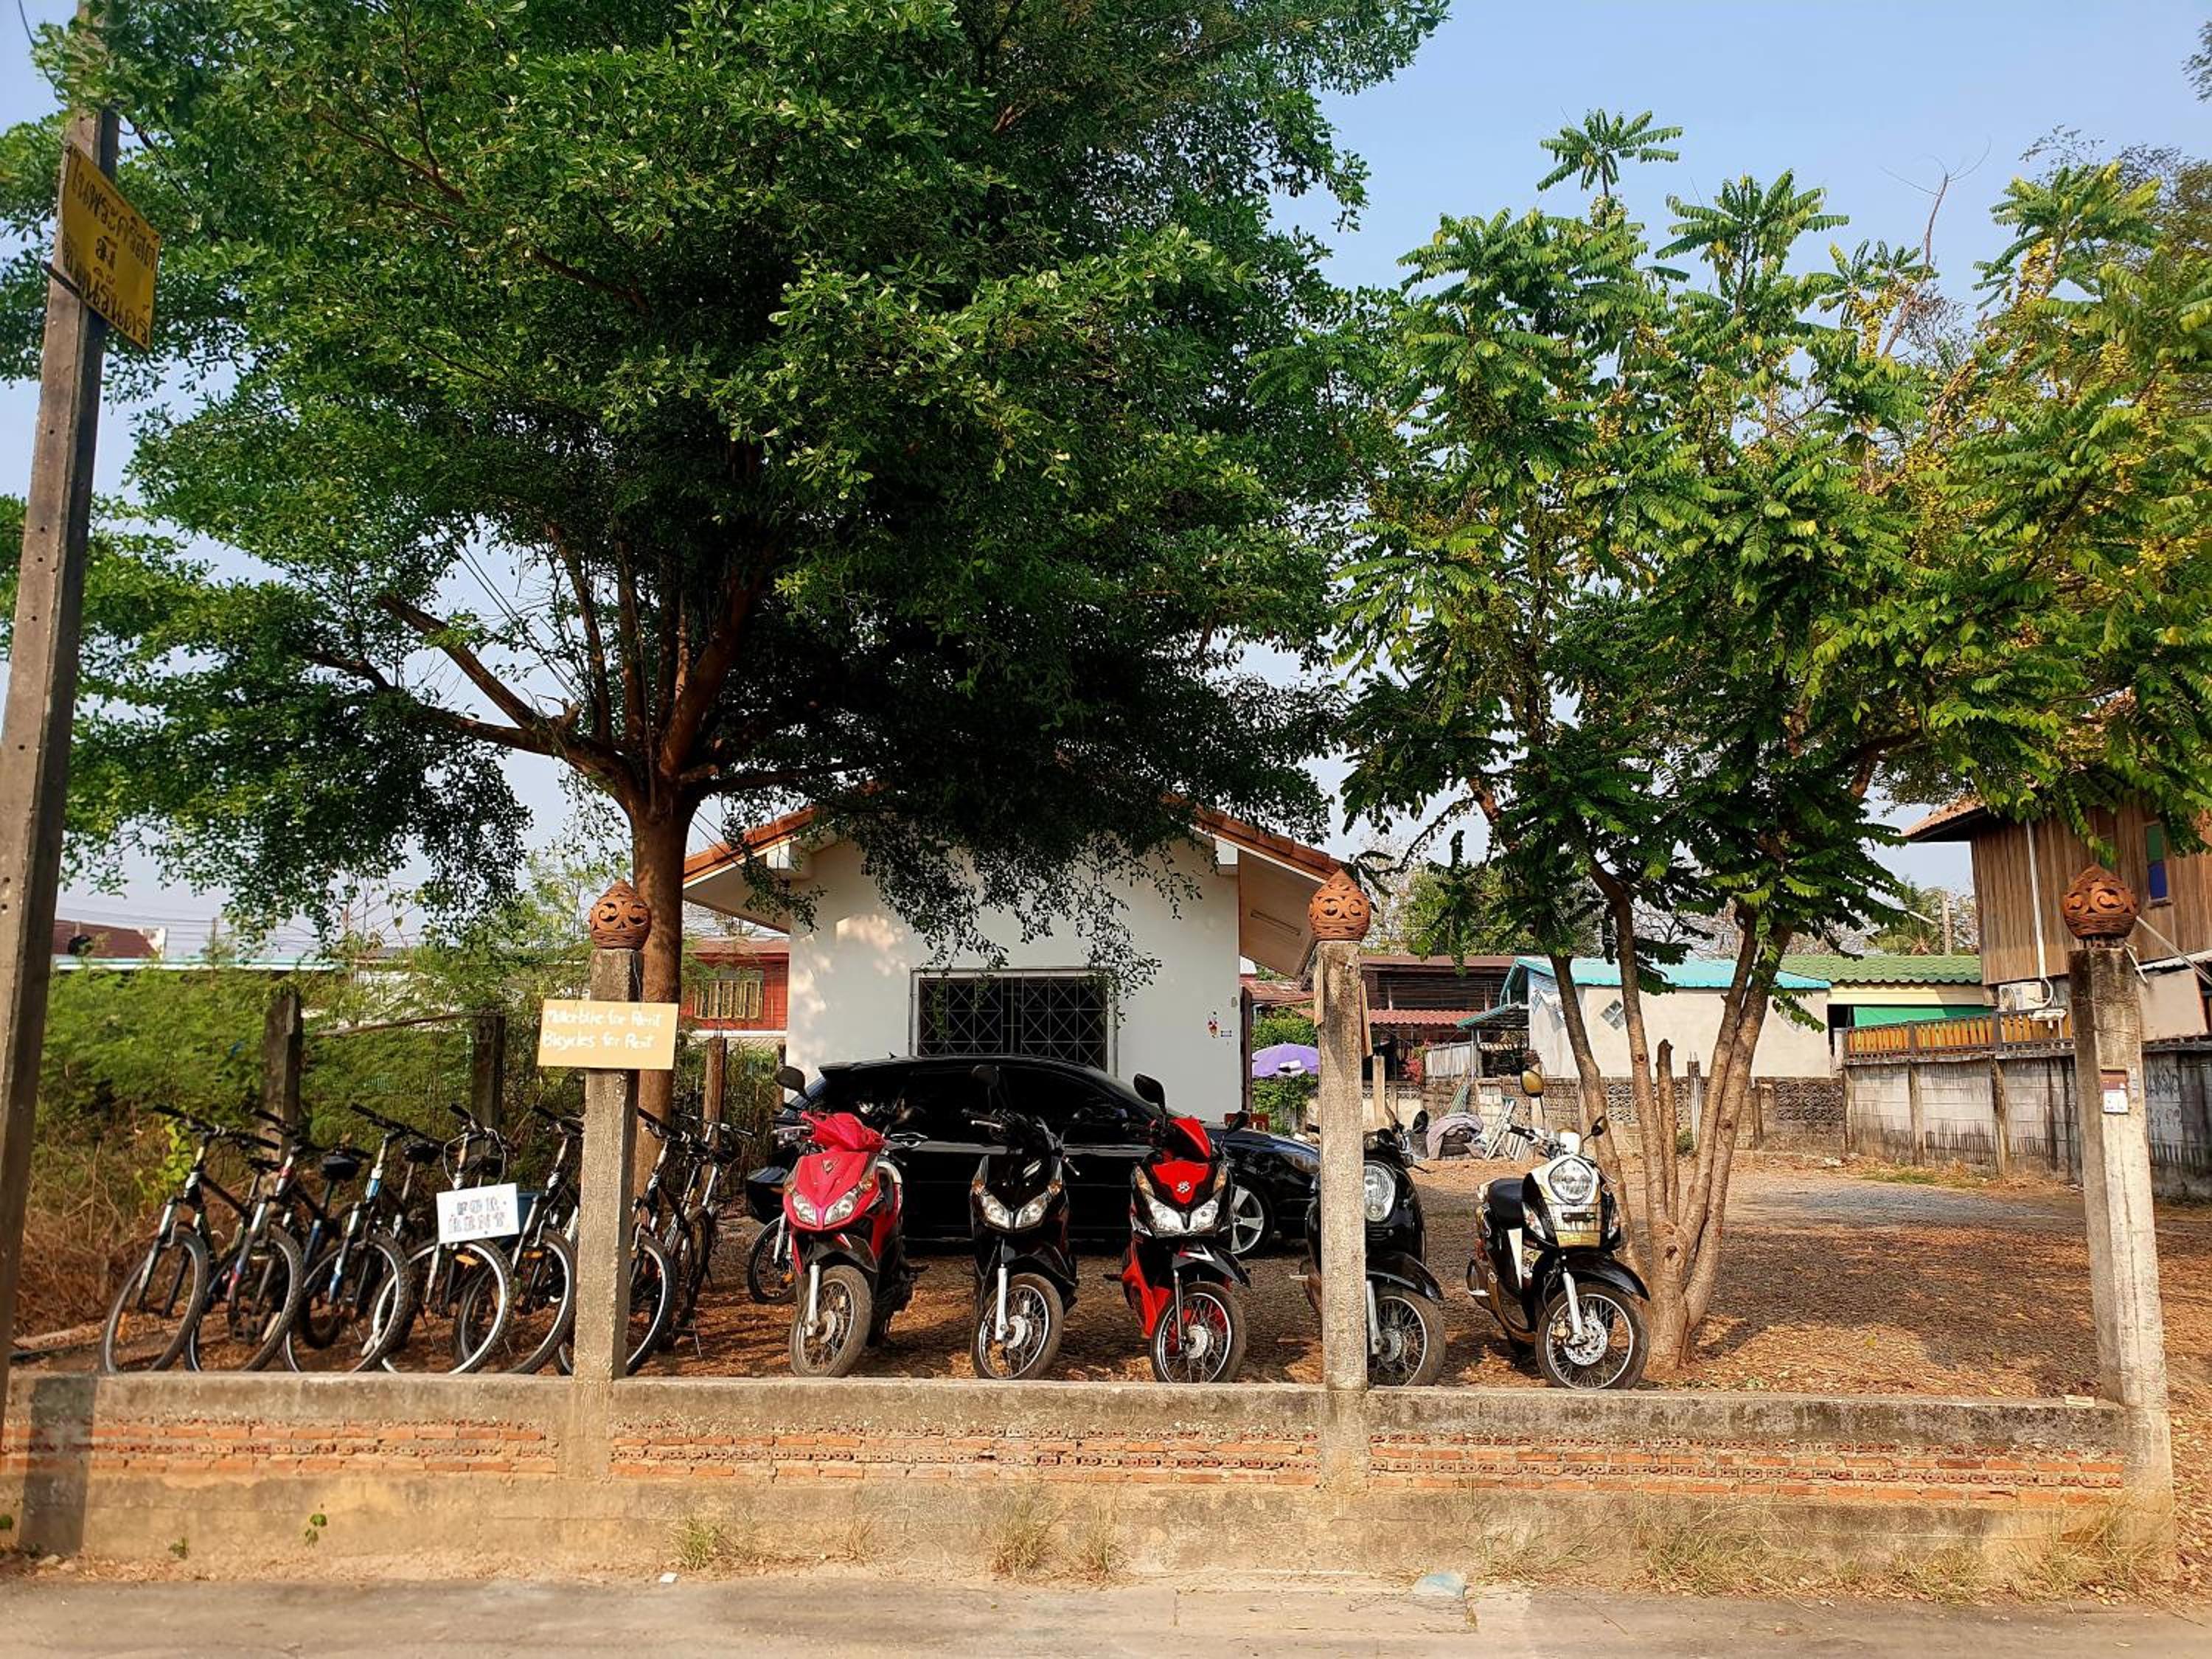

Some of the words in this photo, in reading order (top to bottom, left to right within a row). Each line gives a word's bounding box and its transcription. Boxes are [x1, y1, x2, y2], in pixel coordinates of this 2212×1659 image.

[608, 1008, 626, 1026] for
[632, 1011, 662, 1027] Rent
[542, 1030, 595, 1051] Bicycles
[602, 1031, 621, 1048] for
[625, 1032, 656, 1050] Rent
[448, 1212, 505, 1234] RENT
